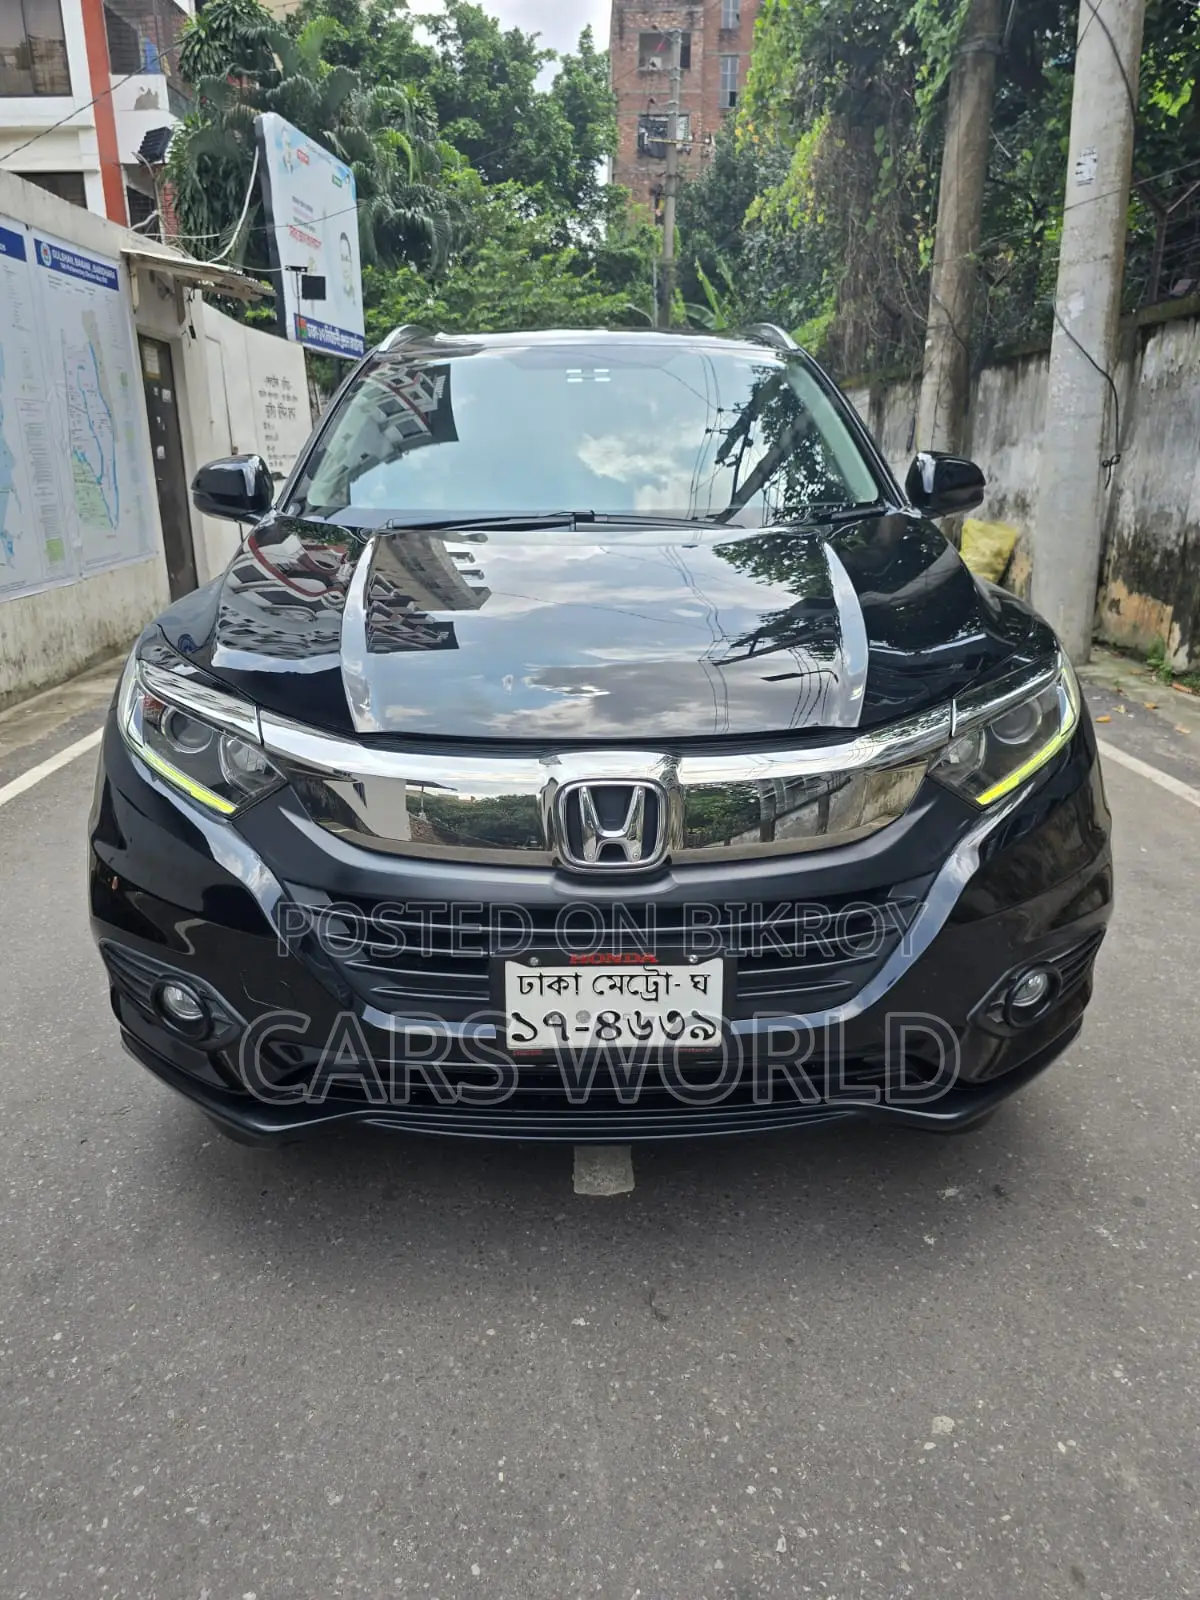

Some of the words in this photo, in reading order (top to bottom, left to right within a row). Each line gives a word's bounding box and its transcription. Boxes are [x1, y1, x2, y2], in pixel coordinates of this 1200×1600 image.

[569, 953, 659, 965] HONDA
[517, 972, 582, 996] ঢাকা
[511, 1009, 717, 1042] ১৭-৪৬৩৯
